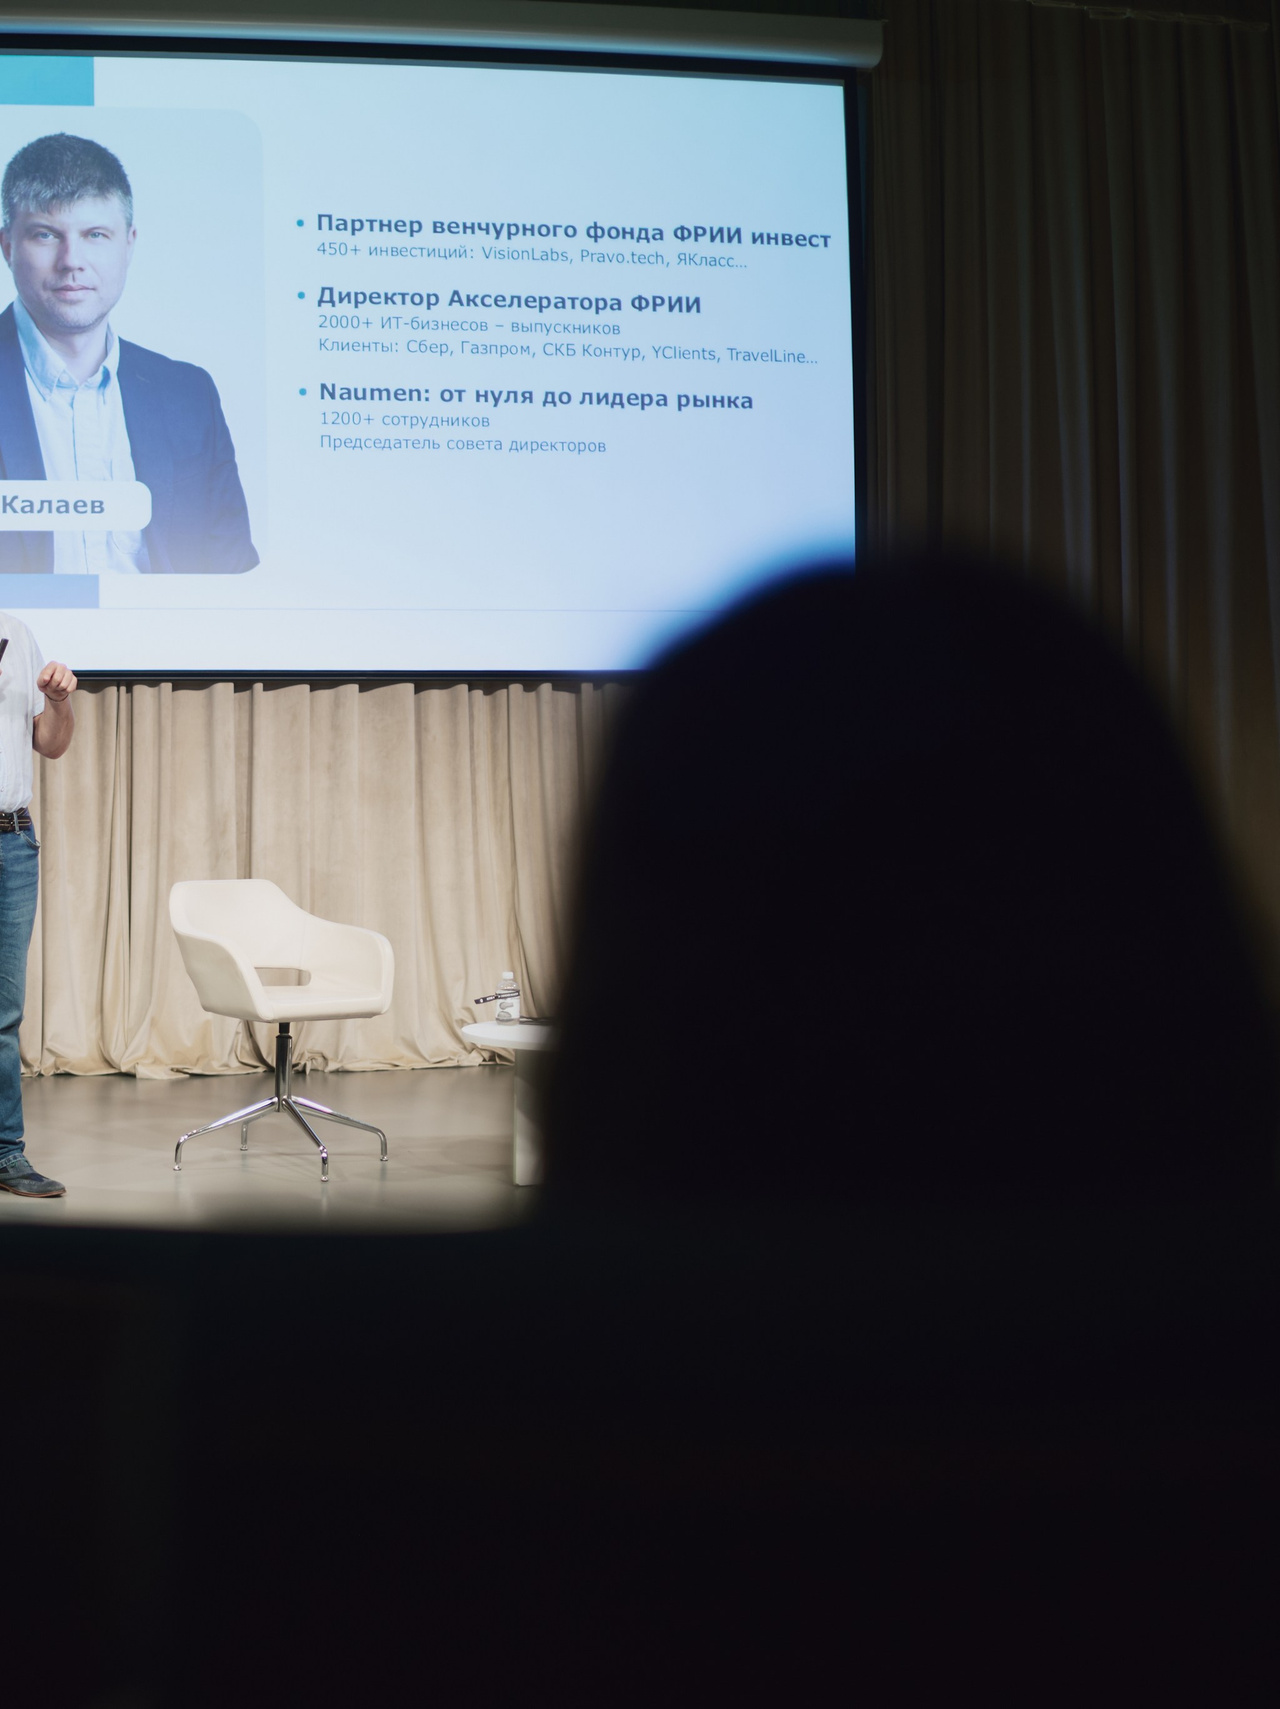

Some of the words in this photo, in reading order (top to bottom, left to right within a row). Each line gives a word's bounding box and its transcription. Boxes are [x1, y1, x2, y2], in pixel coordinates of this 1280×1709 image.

[317, 214, 423, 237] Партнер
[432, 219, 578, 240] венчурного
[585, 221, 664, 243] фонда
[673, 225, 742, 244] ФРИИ
[751, 231, 832, 248] инвест
[317, 242, 361, 256] 450+
[369, 245, 474, 260] инвестиций:
[482, 246, 574, 264] VisionLabs,
[581, 249, 670, 267] Pravo.tech,
[317, 286, 440, 310] Директор
[448, 289, 622, 315] Акселератора
[630, 294, 701, 314] ФРИИ
[319, 315, 373, 328] 2000+
[381, 316, 488, 332] ИТ-бизнесов
[511, 322, 620, 336] выпускников
[319, 338, 399, 353] Клиенты:
[406, 339, 454, 356] Сбер,
[461, 341, 536, 358] Газпром,
[542, 343, 576, 356] СКБ
[582, 344, 645, 361] Контур,
[651, 345, 721, 363] YClients,
[320, 383, 430, 402] Naumen:
[440, 388, 466, 402] от
[475, 389, 534, 407] нуля
[542, 391, 572, 408] до
[579, 391, 668, 410] лидера
[676, 394, 753, 411] рынка
[321, 411, 375, 425] 1200+
[382, 413, 490, 429] сотрудников
[320, 435, 440, 451] Председатель
[447, 438, 502, 451] совета
[508, 440, 607, 455] директоров
[2, 495, 105, 514] Калаев
